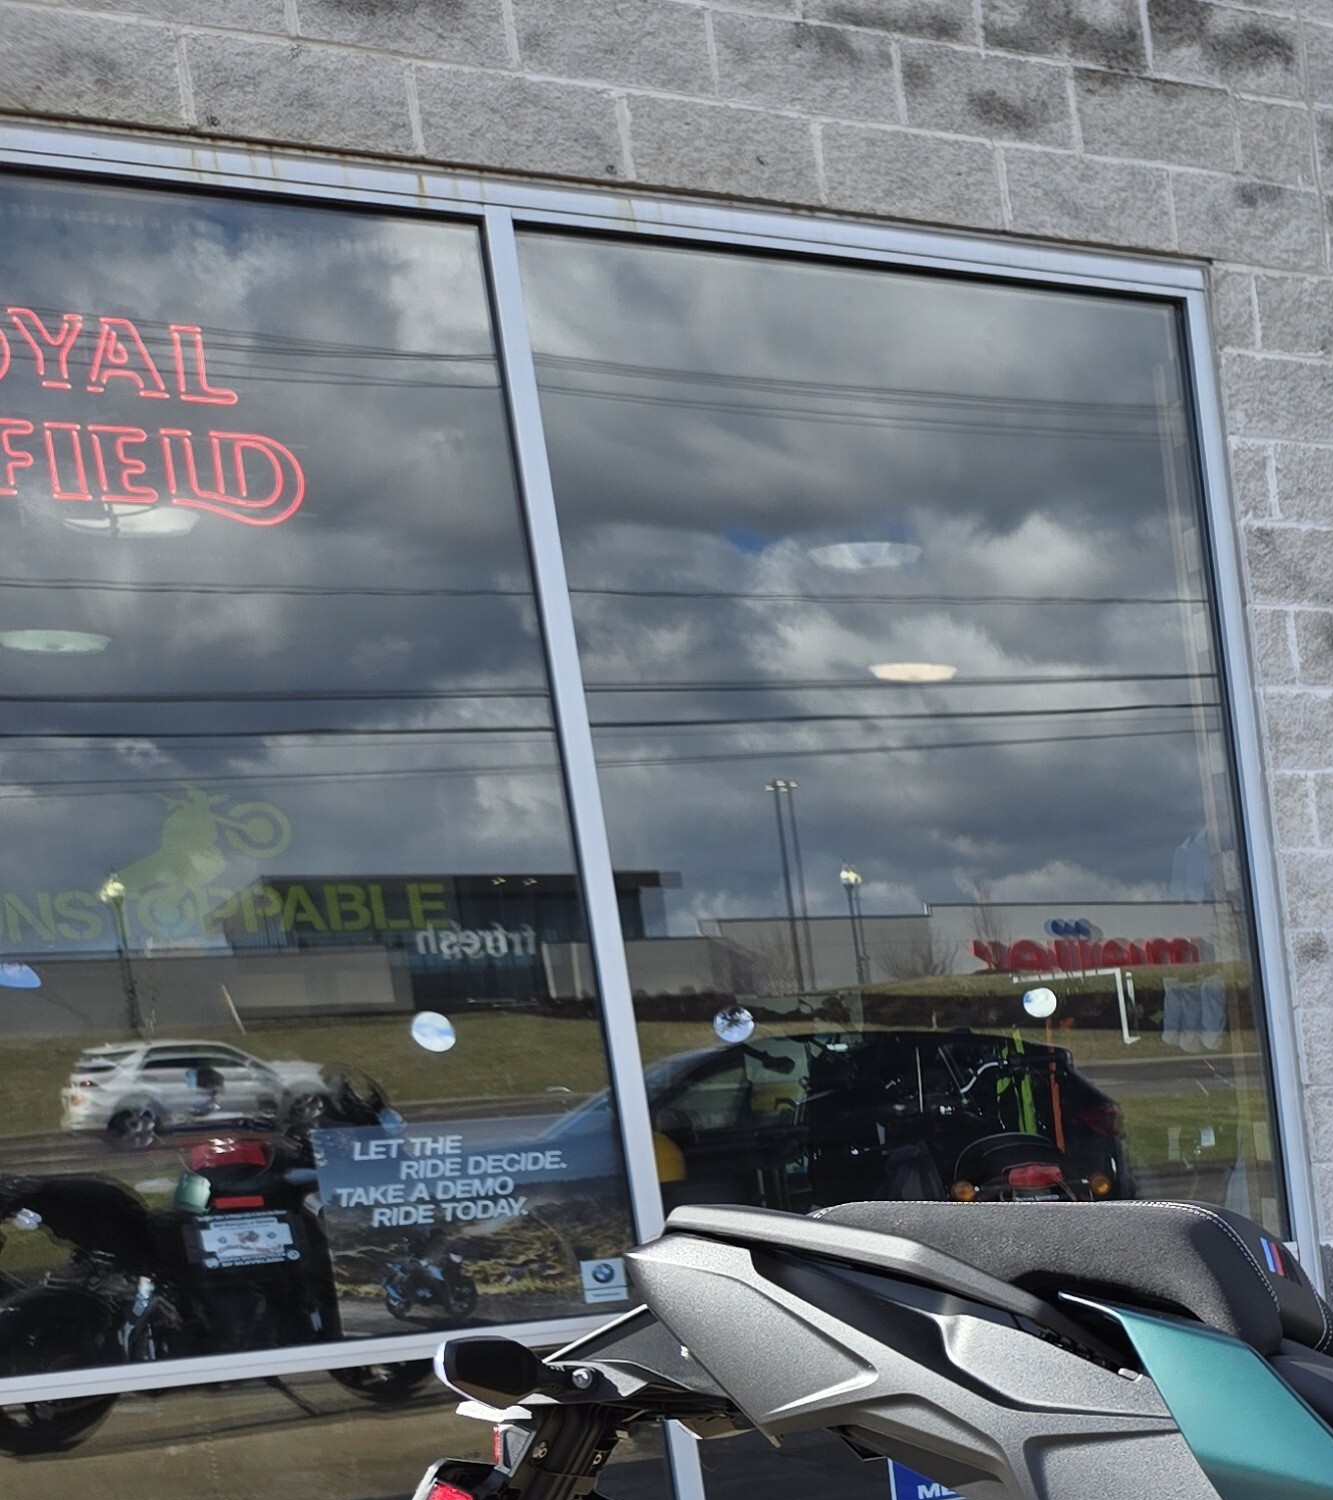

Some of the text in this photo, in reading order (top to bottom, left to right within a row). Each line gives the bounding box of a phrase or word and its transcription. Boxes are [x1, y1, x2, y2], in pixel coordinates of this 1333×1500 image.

[0, 307, 238, 404] YAL
[0, 882, 450, 943] NSTOPPABLE
[353, 1135, 463, 1161] LET THE
[399, 1150, 568, 1180] RIDE DECIDE.
[336, 1175, 515, 1208] TAKE A DEMO
[371, 1196, 529, 1229] RIDE TODAY.
